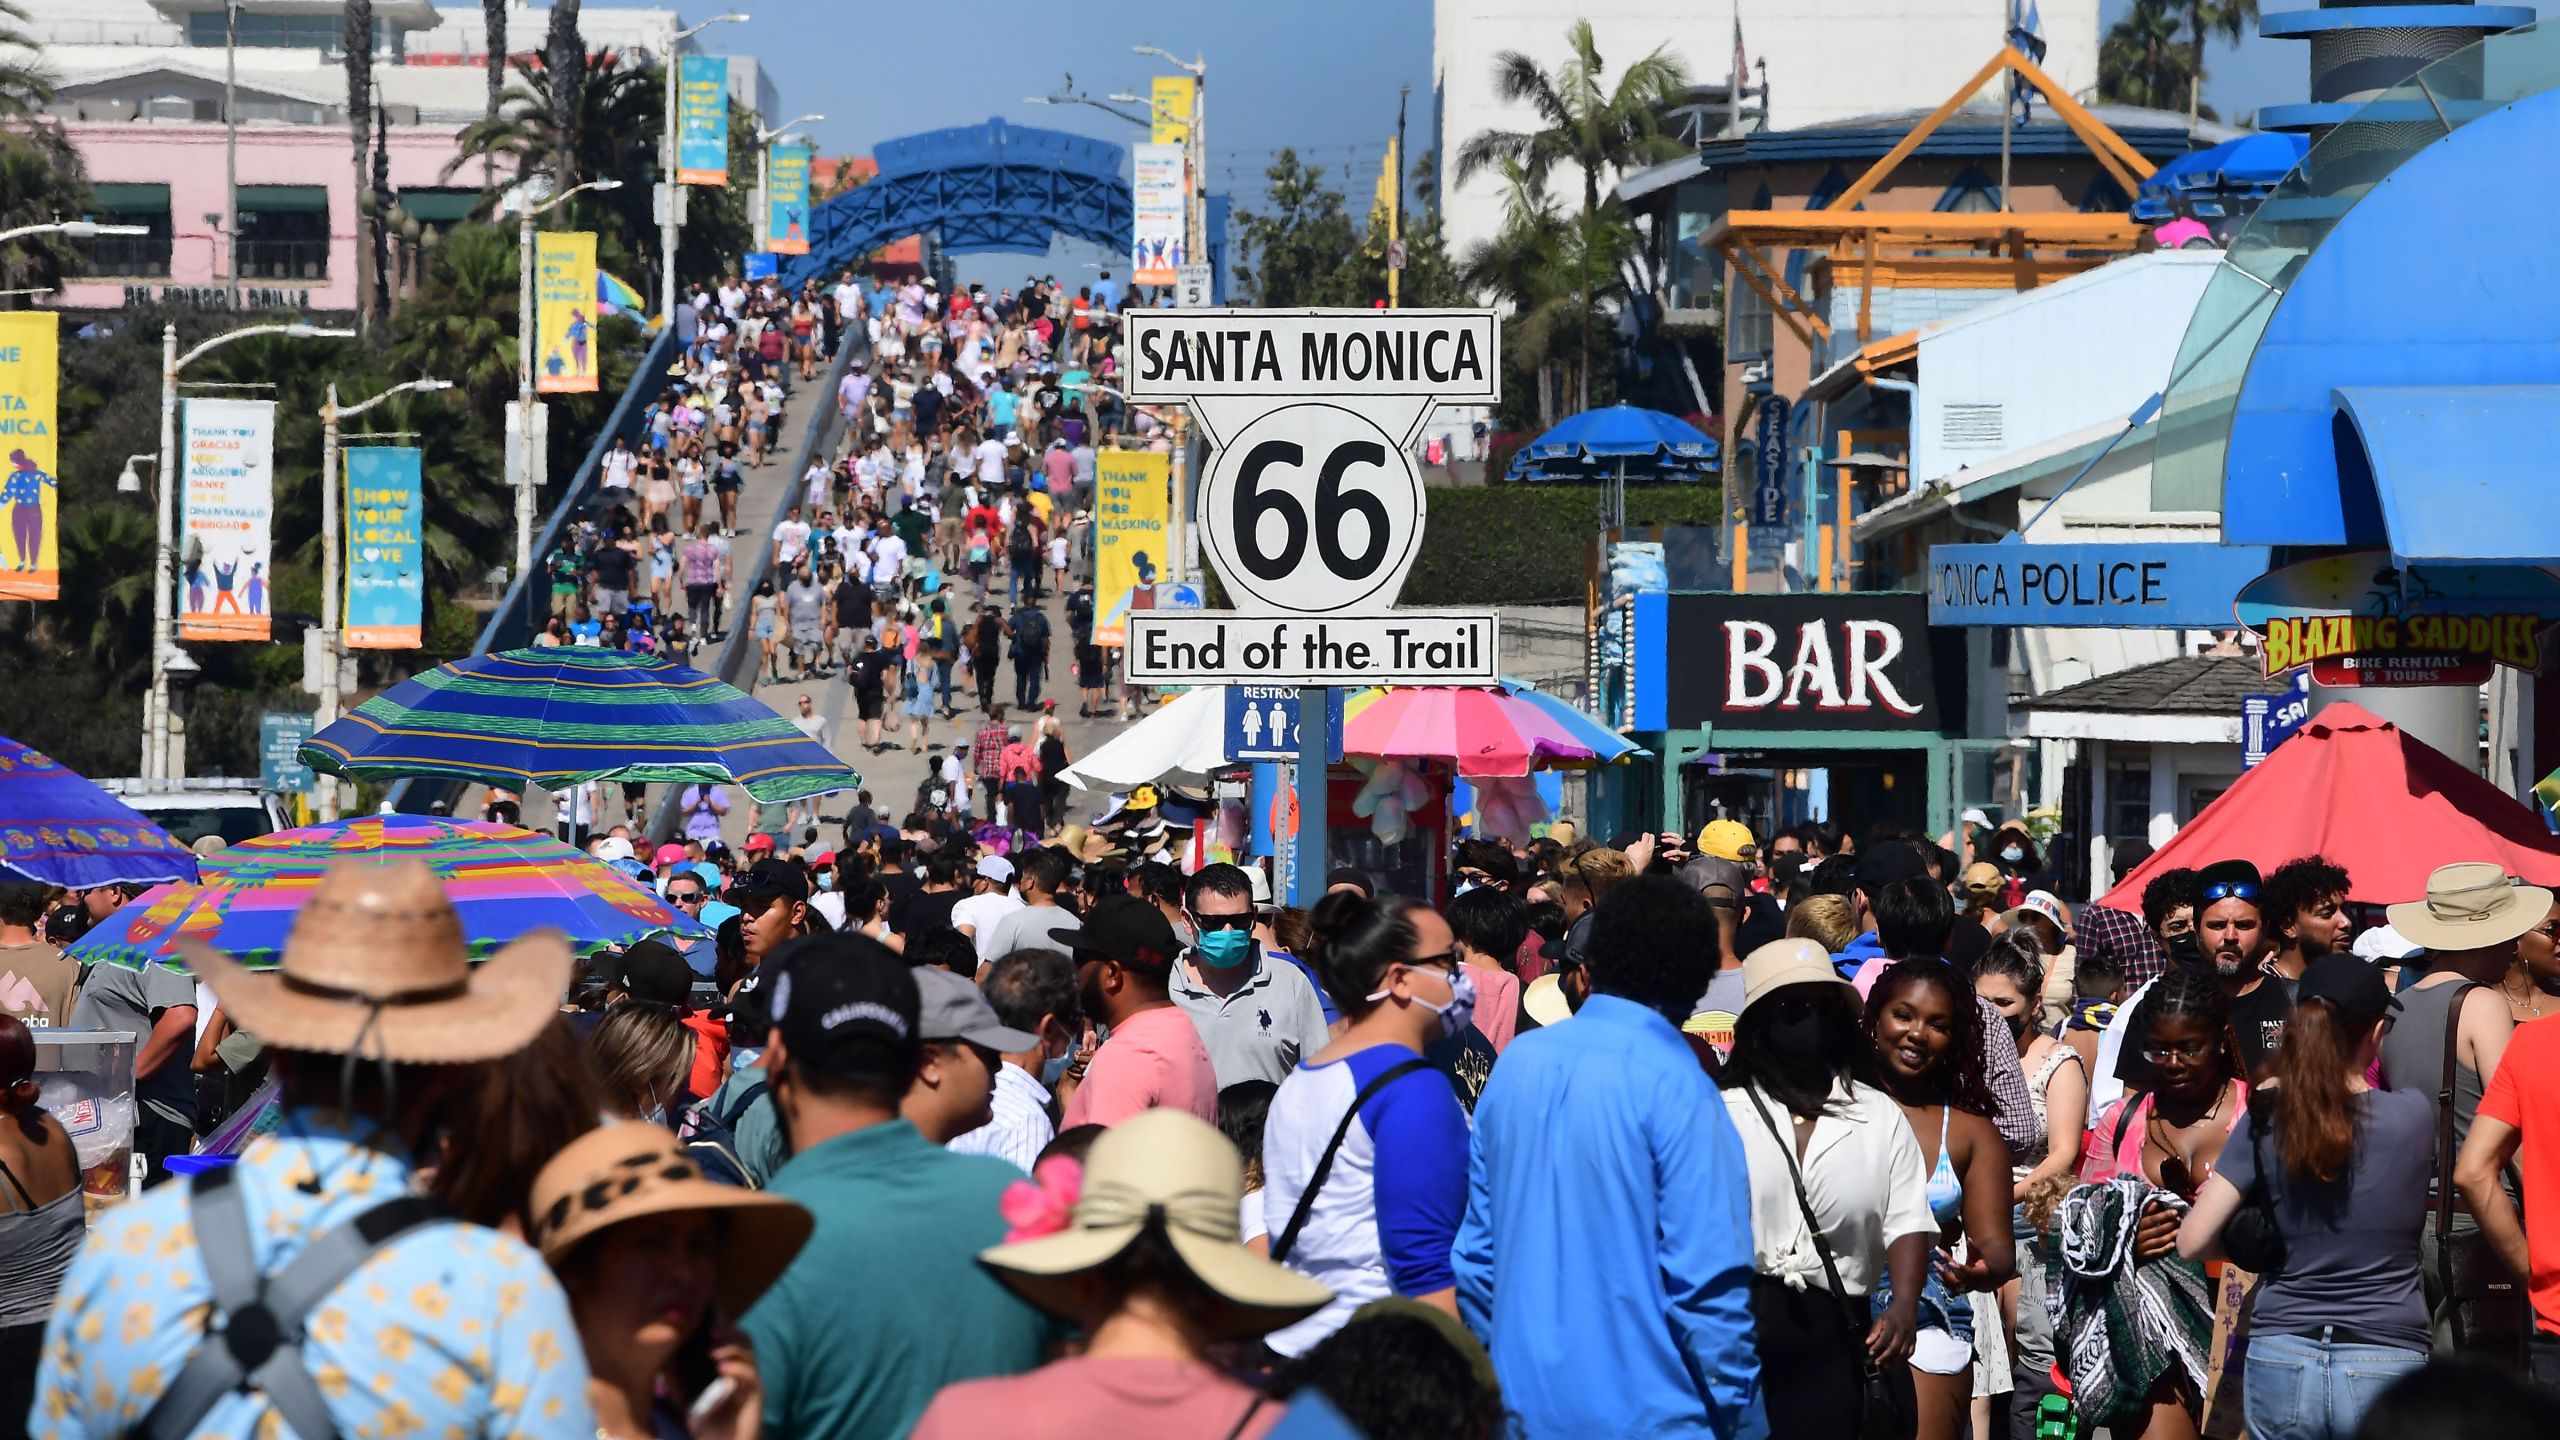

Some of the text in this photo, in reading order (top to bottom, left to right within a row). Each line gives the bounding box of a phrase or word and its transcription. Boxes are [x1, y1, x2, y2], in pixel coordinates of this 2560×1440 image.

[1188, 286, 1200, 304] 5
[1139, 328, 1484, 383] SANTA MONICA
[0, 394, 27, 411] TA
[192, 428, 255, 438] THANK YOU
[192, 441, 240, 450] GRACIAS
[1763, 401, 1782, 523] SEASIDE
[1102, 471, 1147, 484] THANK
[353, 488, 409, 504] SHOW
[1103, 487, 1131, 500] YOU
[1102, 503, 1130, 514] FOR
[1232, 440, 1391, 581] 66
[354, 509, 404, 525] YOUR
[1102, 519, 1161, 532] MASKING
[353, 528, 417, 545] LOCAL
[1102, 534, 1119, 546] UP
[2021, 561, 2169, 605] POLICE
[1144, 623, 1479, 670] End of the Trail
[2263, 613, 2540, 675] BLAZING SADDLES
[1720, 617, 1924, 718] BAR
[2343, 656, 2461, 670] BIKE RENTALS
[2364, 670, 2440, 682] & TOURS
[17, 1015, 49, 1028] oba
